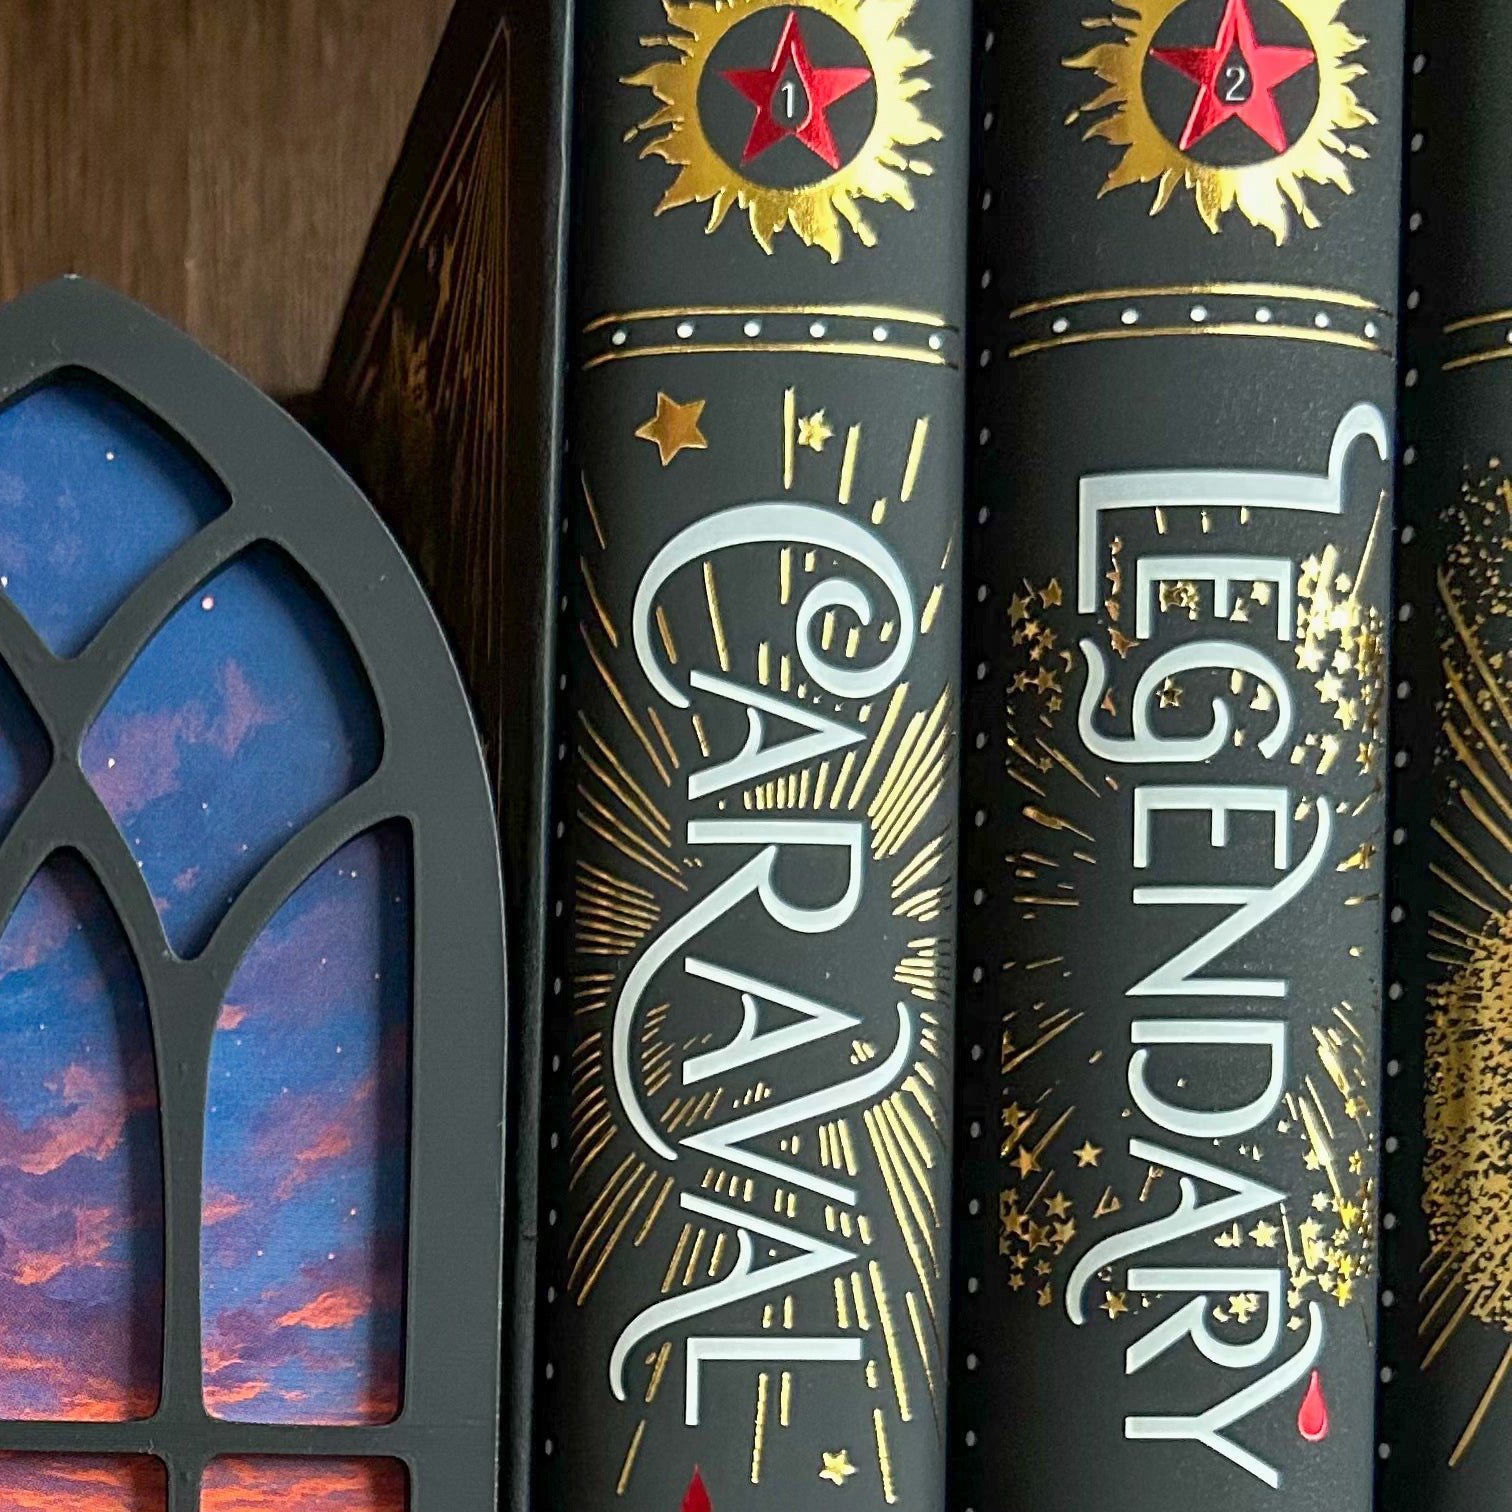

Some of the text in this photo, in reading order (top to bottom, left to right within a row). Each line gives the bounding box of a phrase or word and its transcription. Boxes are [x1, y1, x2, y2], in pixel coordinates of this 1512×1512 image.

[780, 81, 795, 119] 1
[1224, 66, 1247, 102] 2
[609, 501, 915, 1427] CARAVAL
[1065, 402, 1390, 1490] LEGENDARY
